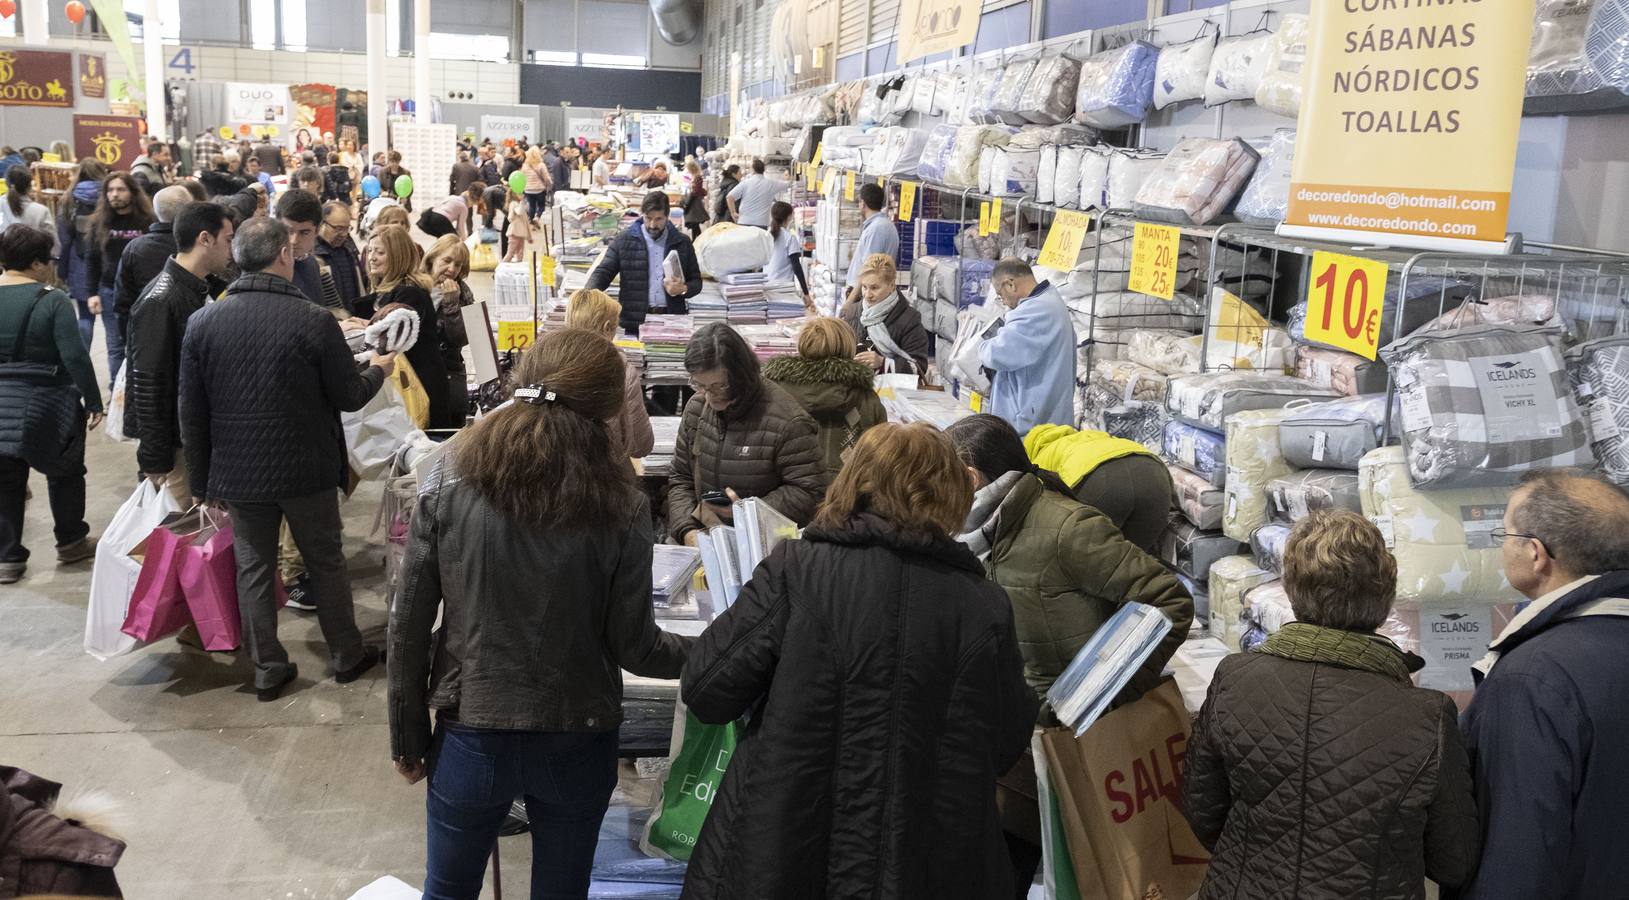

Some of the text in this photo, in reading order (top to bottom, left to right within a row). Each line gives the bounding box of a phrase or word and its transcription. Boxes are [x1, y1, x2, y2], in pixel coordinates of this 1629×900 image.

[1344, 23, 1476, 53] SÁBANAS
[168, 48, 196, 74] 4
[1333, 65, 1480, 93] NÓRDICOS
[239, 90, 273, 100] DUO
[1341, 109, 1460, 133] TOALLAS
[1296, 188, 1496, 212] decoredondo@hotmail.com
[1141, 226, 1171, 242] MANTA
[1308, 212, 1477, 235] www.decoredondo.com
[1154, 244, 1174, 270] 20€
[1315, 263, 1378, 346] 10€
[1486, 368, 1536, 382] ICELANDS
[1431, 622, 1480, 633] ICELANDS
[1444, 652, 1470, 660] PRISMA
